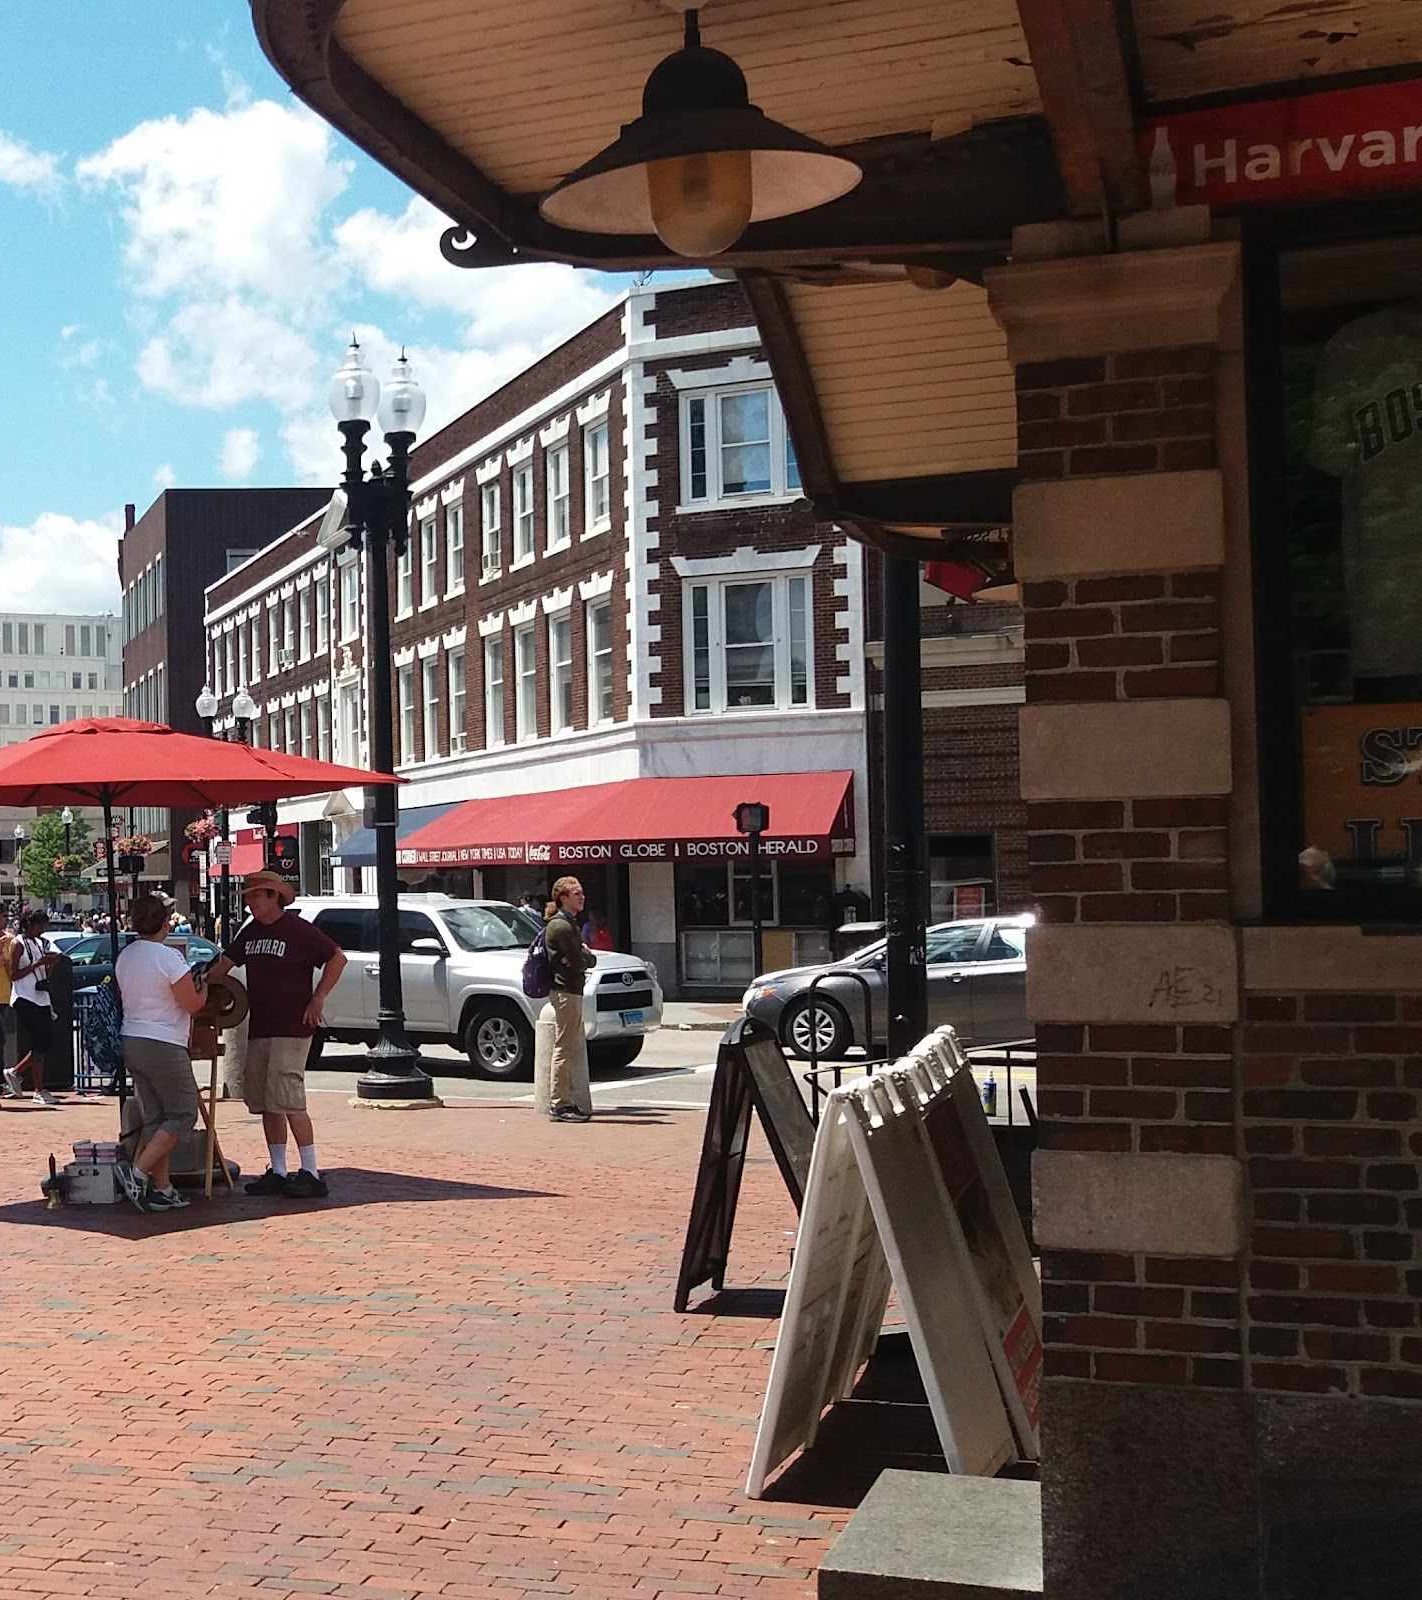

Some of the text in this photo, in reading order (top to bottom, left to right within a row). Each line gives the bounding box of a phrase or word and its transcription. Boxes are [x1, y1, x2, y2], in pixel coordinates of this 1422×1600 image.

[470, 848, 481, 860] YORK
[497, 847, 506, 859] USA
[508, 846, 523, 859] TODAY
[559, 843, 666, 859] BOSTON GLOBE
[687, 841, 750, 856] BOSTON
[758, 839, 818, 855] HERALD
[244, 938, 286, 957] HARVARD
